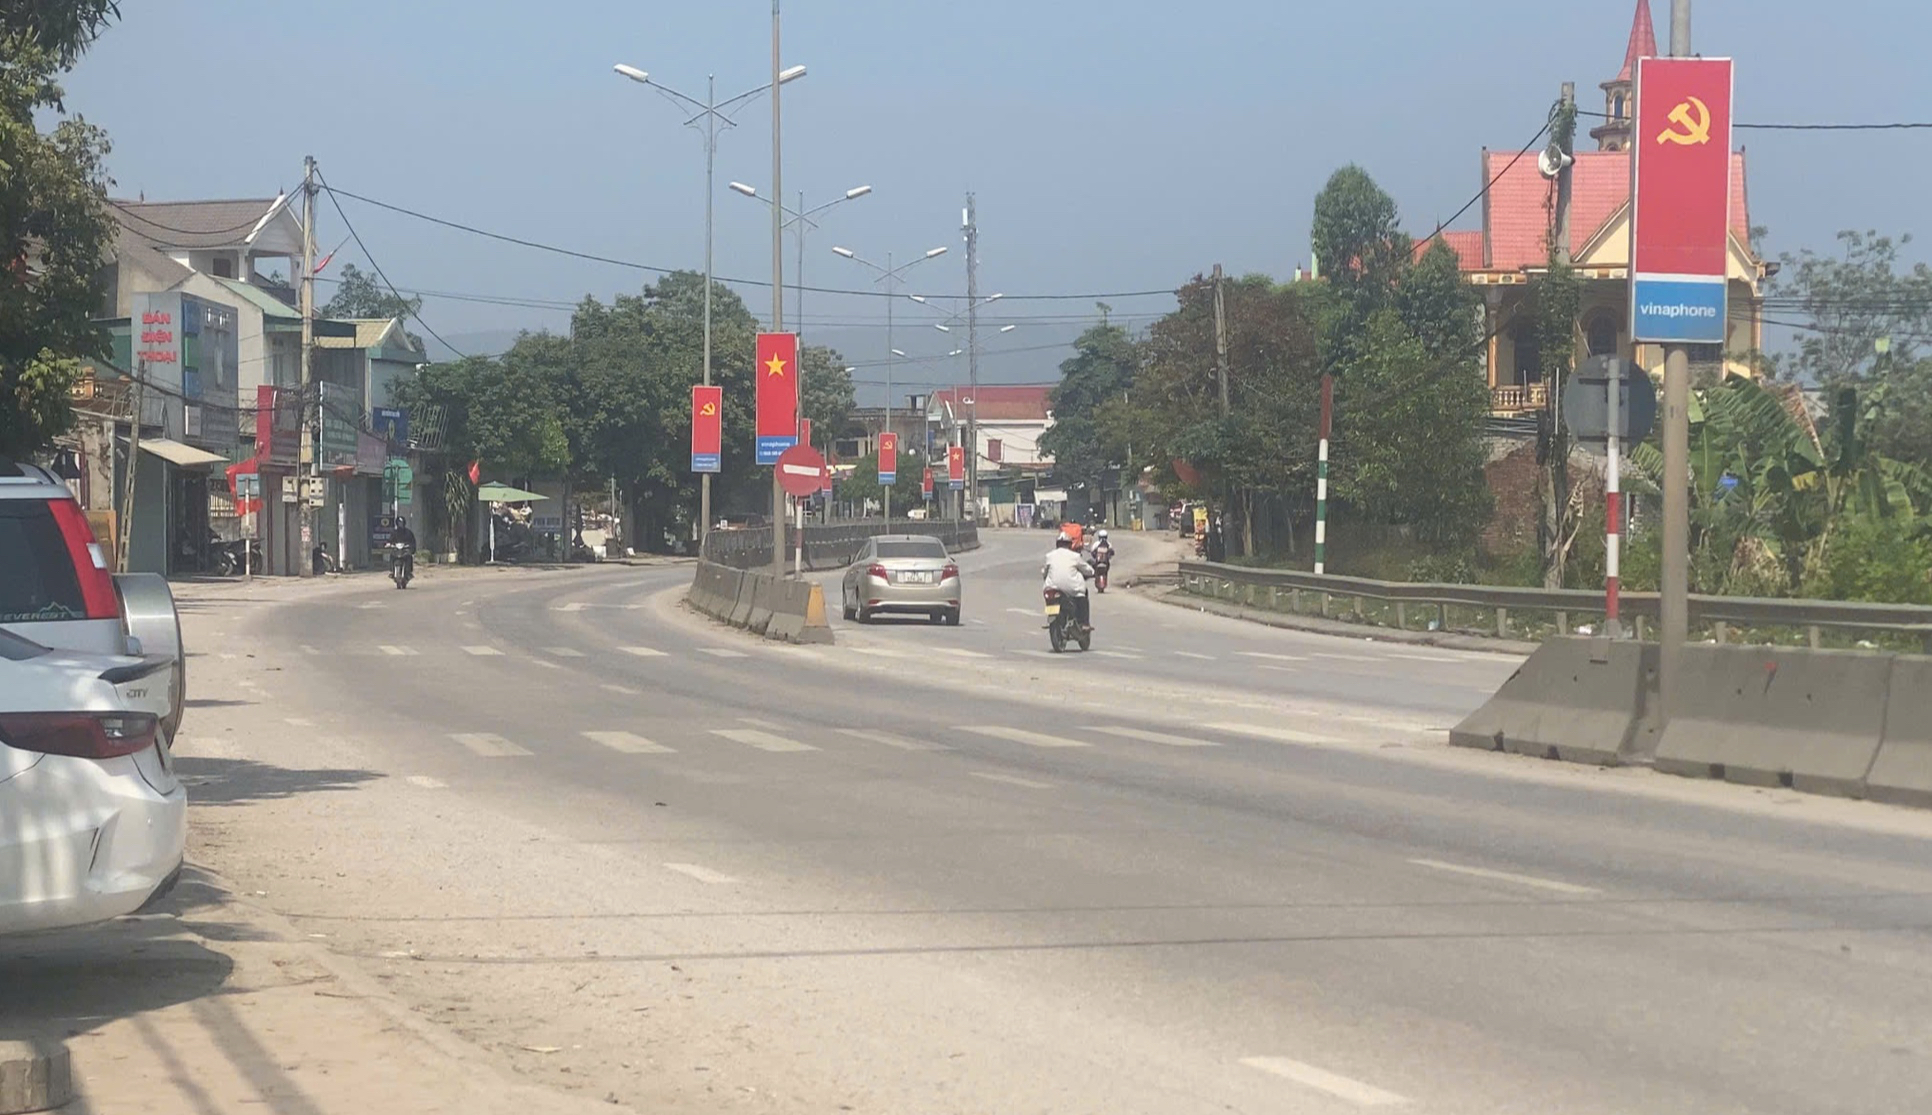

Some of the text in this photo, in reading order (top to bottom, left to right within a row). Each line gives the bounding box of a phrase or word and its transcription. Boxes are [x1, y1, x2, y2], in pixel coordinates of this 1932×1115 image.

[142, 310, 171, 324] BÁN
[1640, 302, 1716, 318] vinaphone
[141, 329, 172, 345] ĐIỆN
